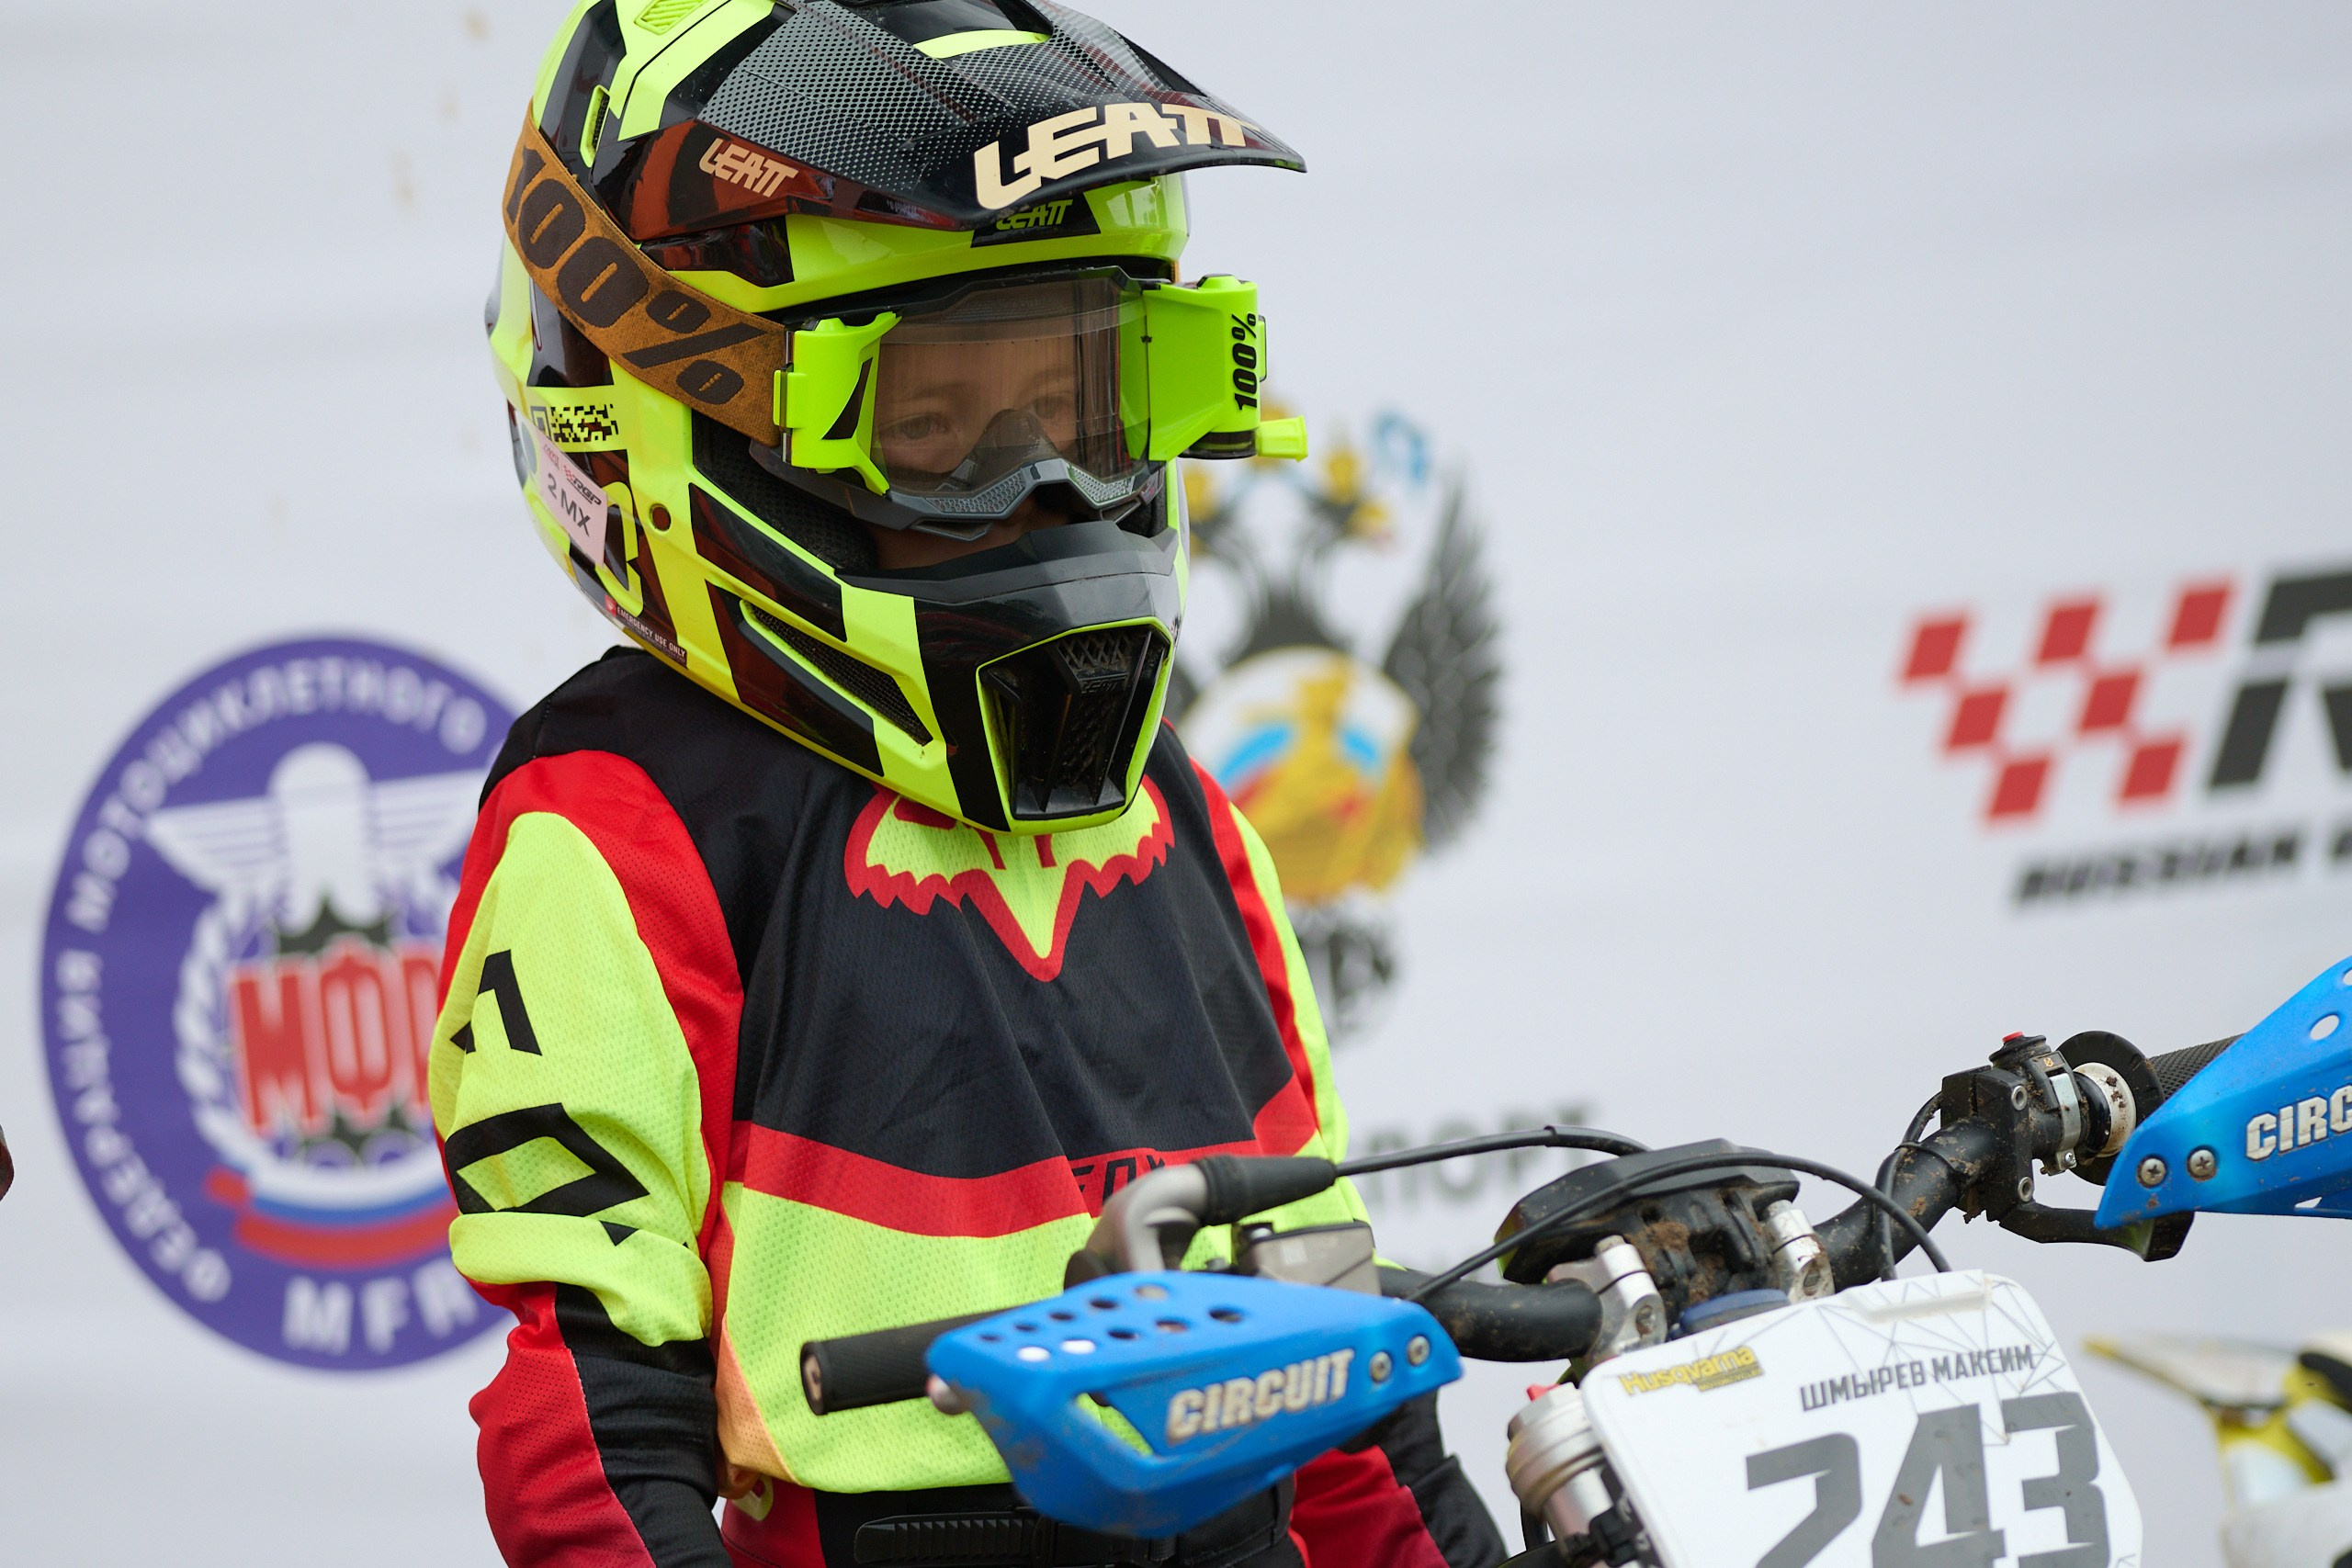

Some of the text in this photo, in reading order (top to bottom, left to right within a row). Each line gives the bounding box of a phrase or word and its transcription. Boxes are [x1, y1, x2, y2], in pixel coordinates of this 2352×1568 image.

[698, 138, 798, 197] LEATT
[974, 103, 1261, 210] LEATT
[506, 144, 768, 405] 100%
[1232, 311, 1258, 412] 100%
[573, 477, 603, 506] RGP
[616, 606, 686, 658] EMERGENCY USE ONLY
[1166, 1348, 1356, 1447] CIRCUIT
[1618, 1345, 1758, 1396] Husqvarna
[1800, 1344, 2036, 1412] ШМЫРЕВ МАКСИМ
[1746, 1391, 2112, 1568] 243
